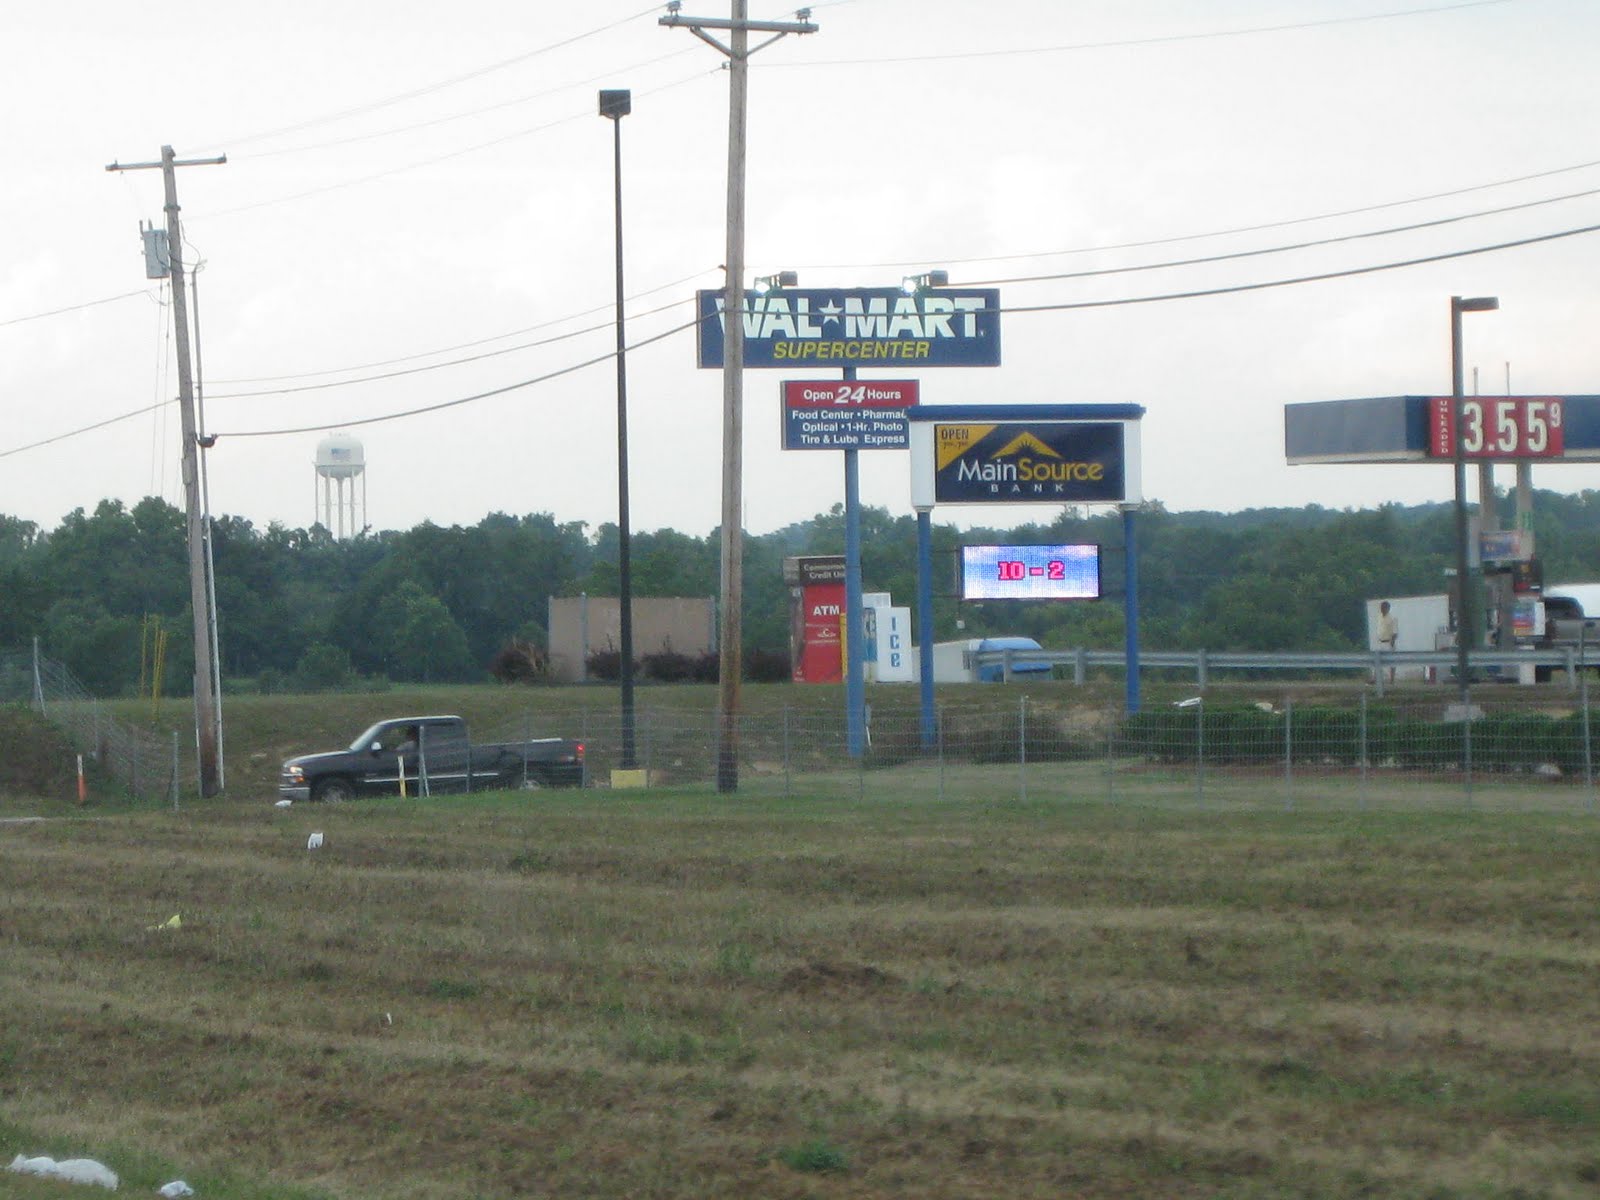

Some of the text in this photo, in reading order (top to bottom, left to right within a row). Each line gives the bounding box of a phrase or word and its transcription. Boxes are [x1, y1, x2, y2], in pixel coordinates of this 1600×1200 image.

[773, 341, 930, 359] SUPERCENTER
[803, 386, 902, 404] Open 24 Hours
[792, 410, 818, 420] Food
[820, 410, 854, 420] Center
[802, 422, 903, 433] Optical 1-Hr. Photo
[941, 428, 970, 440] OPEN
[800, 434, 906, 446] Tire & Lube Express
[990, 483, 1065, 494] BANK
[809, 571, 832, 580] Credit
[997, 560, 1026, 581] 10
[1047, 560, 1066, 581] 2
[813, 605, 840, 616] ATM
